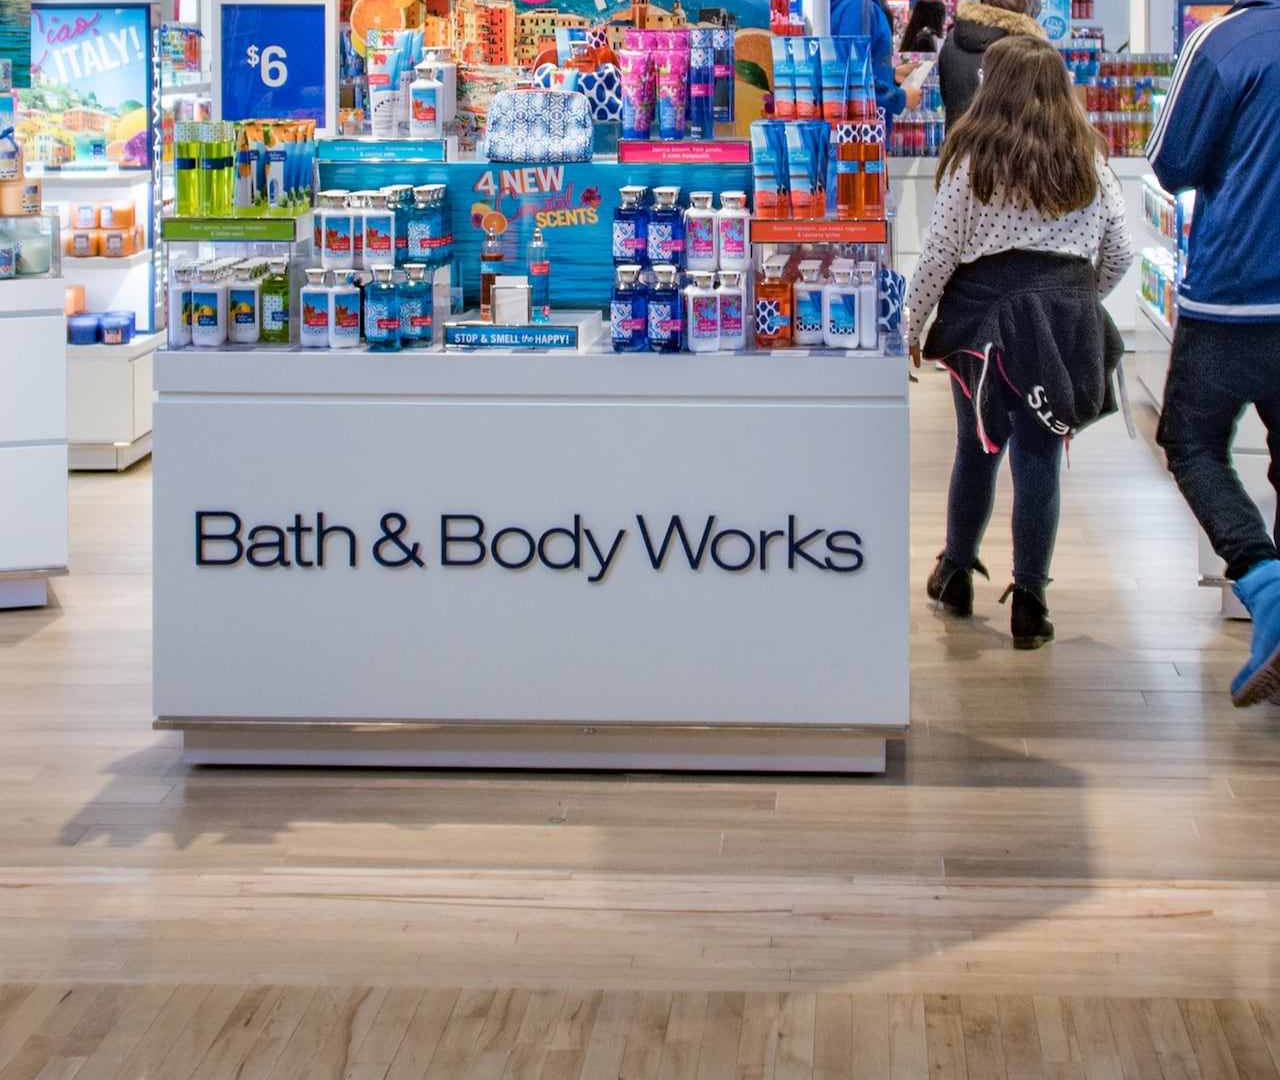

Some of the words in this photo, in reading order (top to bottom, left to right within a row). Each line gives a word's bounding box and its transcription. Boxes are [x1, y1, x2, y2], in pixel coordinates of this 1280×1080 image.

[52, 25, 145, 83] ITALY!
[247, 44, 288, 88] $6
[474, 170, 499, 197] 4
[499, 165, 565, 197] NEW
[535, 206, 599, 229] SCENTS
[455, 332, 477, 344] STOP
[480, 333, 488, 344] &
[490, 333, 519, 344] SMELL
[535, 333, 569, 345] HAPPY!
[194, 509, 358, 569] Bath
[371, 512, 426, 570] &
[440, 512, 628, 583] Body
[635, 514, 866, 575] Works
